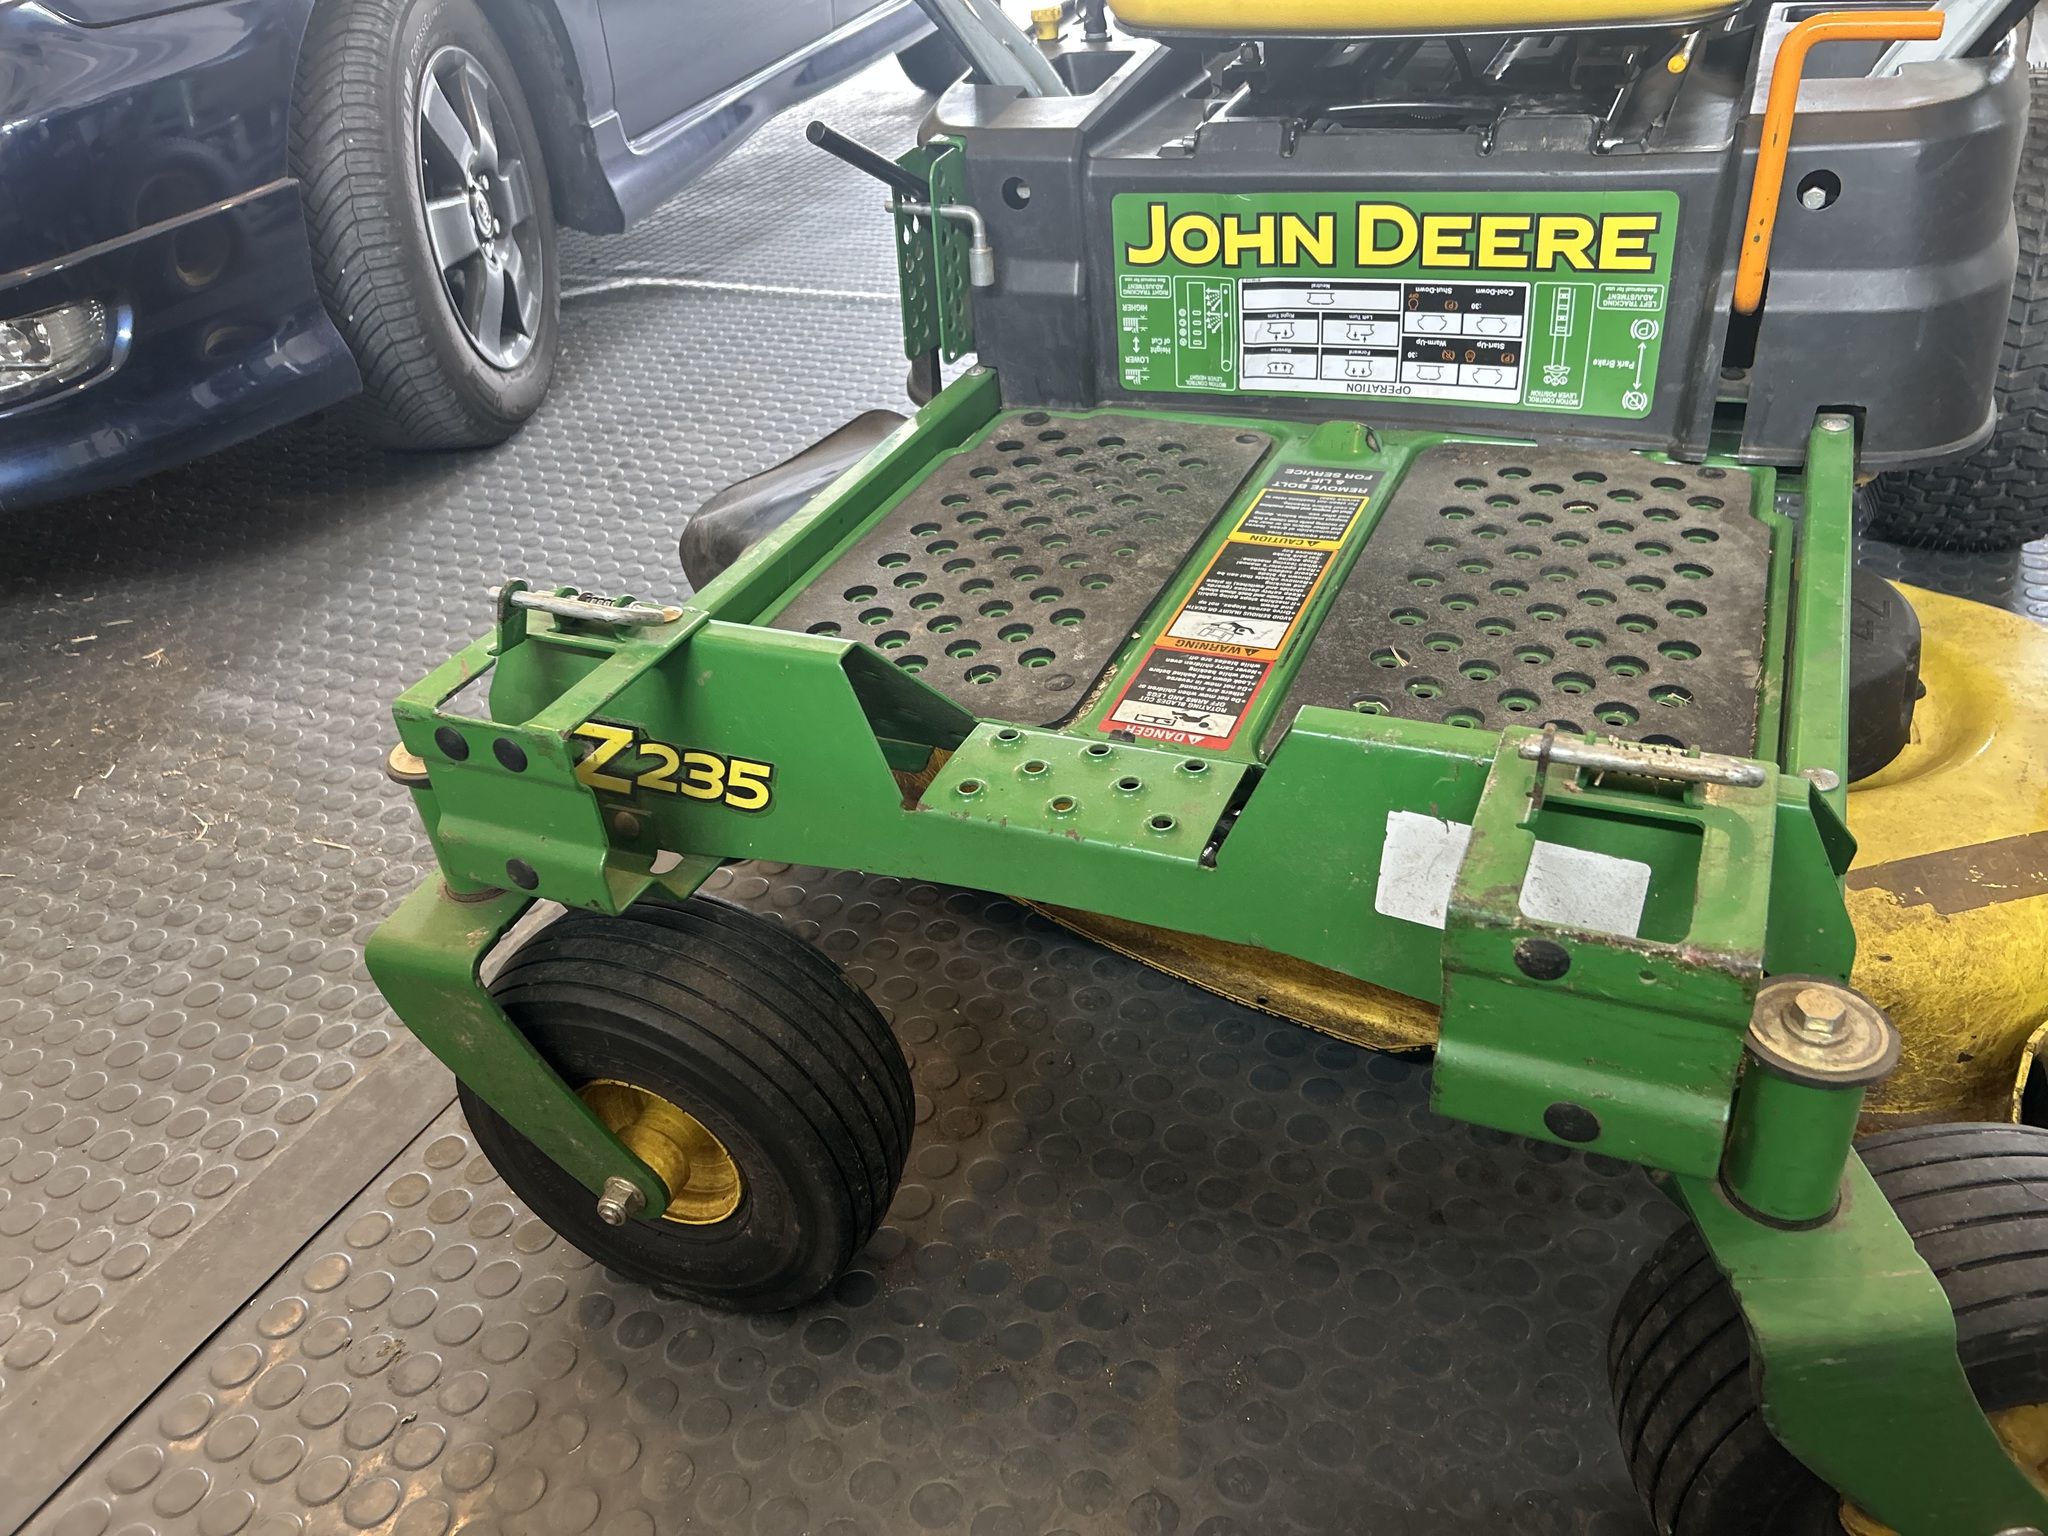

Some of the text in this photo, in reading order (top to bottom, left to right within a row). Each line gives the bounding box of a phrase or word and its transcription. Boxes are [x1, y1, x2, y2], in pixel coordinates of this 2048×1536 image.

[1124, 201, 1664, 271] JOHN DEERE
[1415, 286, 1452, 294] Shut-Down
[1475, 288, 1514, 296] Cool-Down
[1606, 293, 1654, 301] ADJUSTMENT
[1122, 304, 1148, 312] HIGHER
[1470, 302, 1482, 310] :30
[1602, 299, 1657, 308] LEFT TRACKING
[1416, 338, 1447, 346] Warm-Up
[1476, 340, 1505, 350] Start-Up
[1150, 346, 1171, 354] Height
[1124, 356, 1149, 364] LOWER
[1592, 358, 1635, 369] Park Brake
[1346, 384, 1411, 394] OPERATION
[1530, 390, 1557, 398] POSITION
[1528, 396, 1578, 405] MOTION CONTROL
[1285, 469, 1341, 477] SERVICE
[1272, 481, 1368, 493] REMOVE BOLT
[1250, 535, 1304, 545] CAUTION
[1175, 640, 1240, 654] WARNING
[1188, 666, 1217, 675] backing
[1147, 685, 1176, 693] children
[1156, 698, 1186, 706] BLADES
[1188, 703, 1227, 713] ROTATING
[1125, 725, 1185, 742] DANGER
[573, 719, 774, 813] Z235
